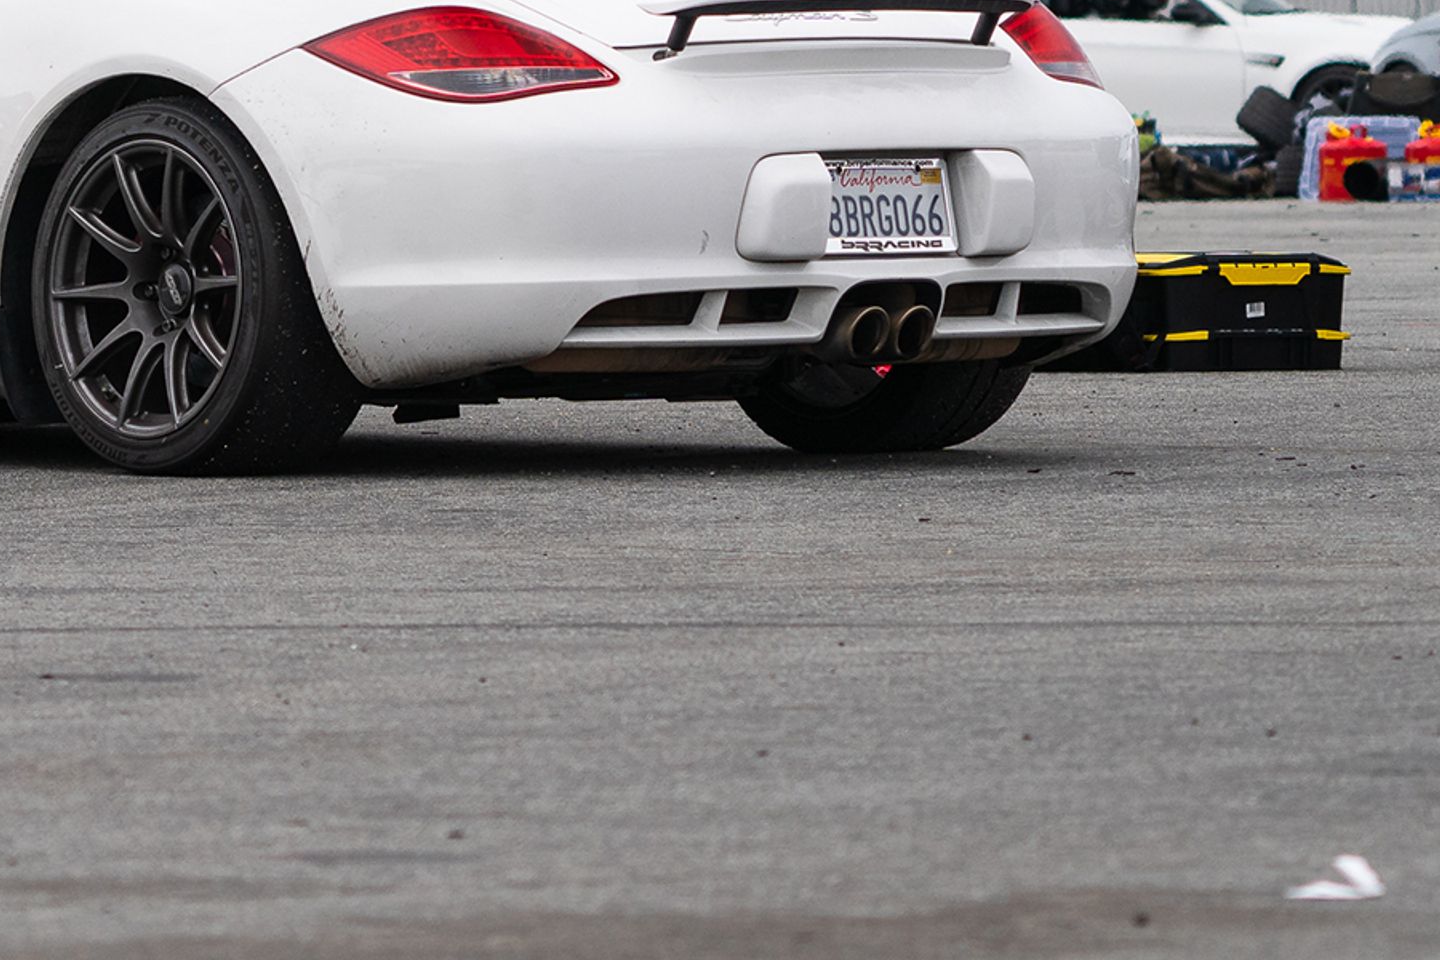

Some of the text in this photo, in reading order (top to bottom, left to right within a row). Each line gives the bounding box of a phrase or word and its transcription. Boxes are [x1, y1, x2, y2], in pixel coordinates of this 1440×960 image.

[164, 115, 241, 194] POTENZA
[840, 169, 920, 192] California
[829, 194, 944, 238] 8BRG066
